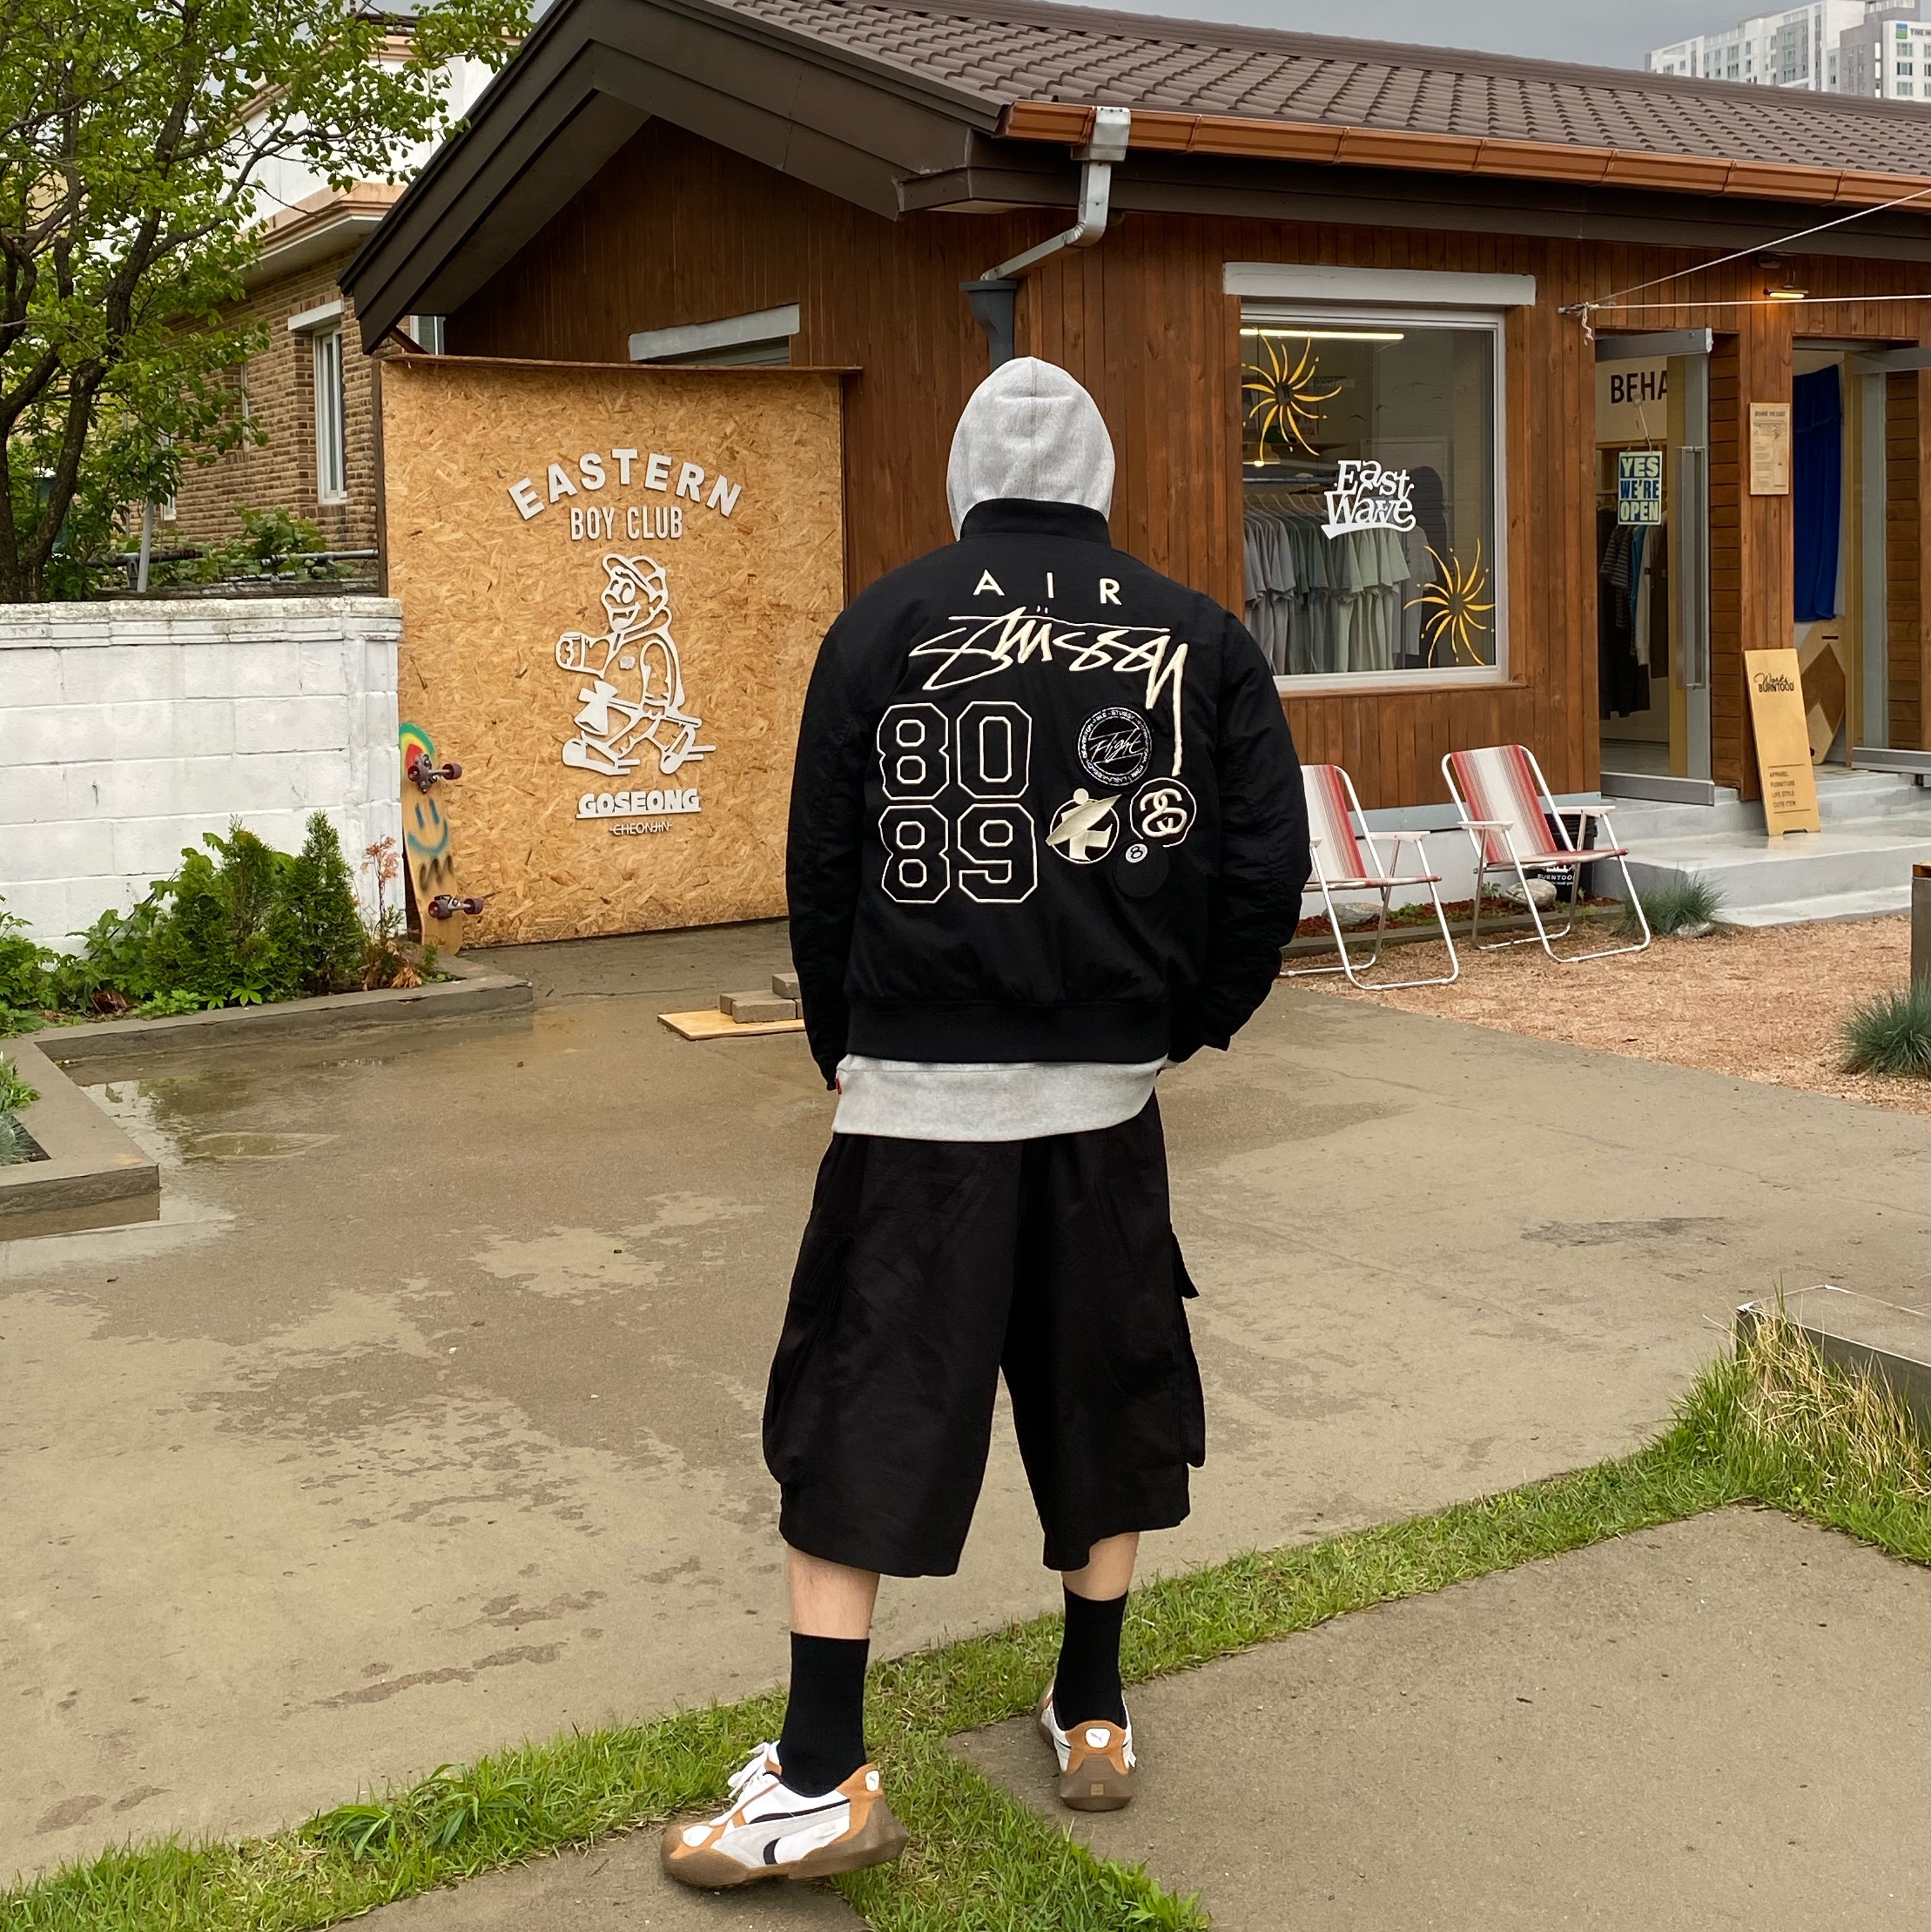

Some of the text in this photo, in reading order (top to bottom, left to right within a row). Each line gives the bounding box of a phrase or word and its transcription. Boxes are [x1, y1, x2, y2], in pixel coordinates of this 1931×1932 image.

[508, 448, 742, 521] EASTERN
[1338, 460, 1411, 499] East
[1621, 457, 1659, 478] YES
[1621, 480, 1659, 499] WE'RE
[570, 505, 683, 540] BOY CLUB
[1322, 487, 1416, 534] Wave
[1621, 501, 1659, 521] OPEN
[973, 569, 1122, 605] AIR
[877, 701, 1032, 800] 80
[578, 788, 700, 816] GOSEONG
[611, 820, 670, 835] CHEONJIN
[879, 802, 1038, 904] 89
